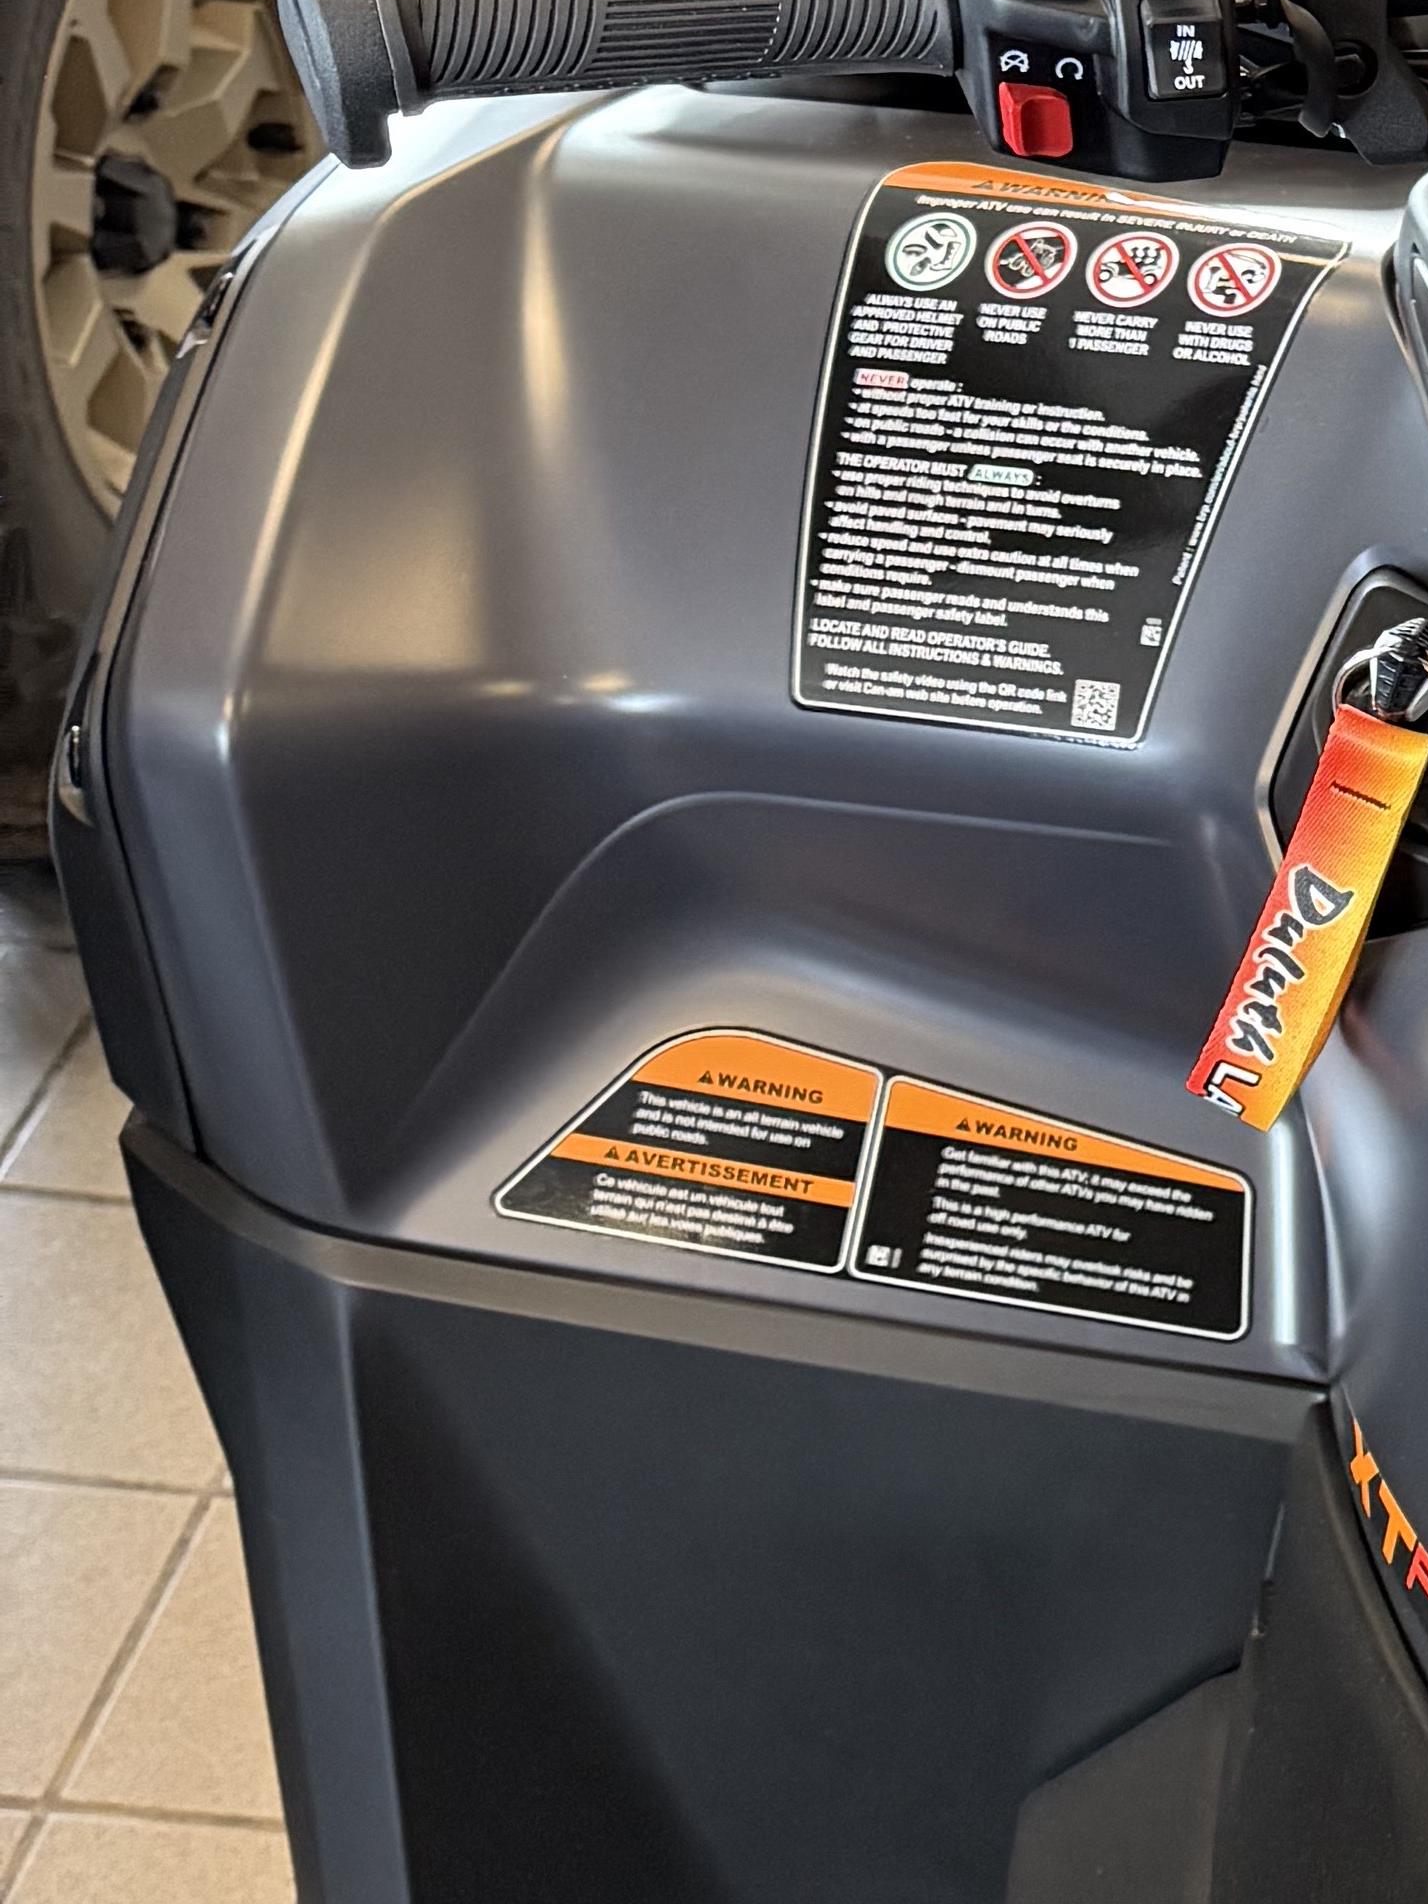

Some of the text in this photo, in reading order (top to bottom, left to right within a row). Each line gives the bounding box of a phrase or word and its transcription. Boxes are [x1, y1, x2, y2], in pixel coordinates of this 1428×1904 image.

[1177, 25, 1196, 38] IN
[1174, 75, 1206, 90] OUT
[865, 294, 957, 311] ALWAYS USE AN
[979, 303, 1047, 318] NEVER USE
[851, 305, 963, 324] APPROVED HELMET
[976, 316, 1041, 331] ON PUBLIC
[1073, 311, 1158, 328] NEVER CARRY
[851, 319, 953, 337] AND PROTECTIVE
[983, 330, 1027, 344] ROADS
[1076, 324, 1147, 341] MORE THAN
[1185, 321, 1253, 337] NEVER USE
[848, 331, 953, 350] GEAR FOR DRIVER
[1068, 337, 1148, 354] 1 PASSENGER
[1178, 333, 1253, 351] WITH DRUGS
[848, 345, 946, 363] AND PASSENGER
[1172, 346, 1250, 365] OR ALCOHOL
[861, 373, 955, 391] NEVER operate
[836, 451, 1030, 482] THE OPERATOR MUST ALWAYS
[810, 618, 1050, 657] LOCATE AND READ OPERATOR'S GUIDE.
[808, 633, 1063, 674] FOLLOW ALL INSTRUCTIONS & WARNINGS.
[1228, 865, 1354, 1066] Duluth
[717, 1071, 824, 1105] WARNING
[975, 1119, 1079, 1152] WARNING
[624, 1151, 815, 1195] AVERTISSEMENT
